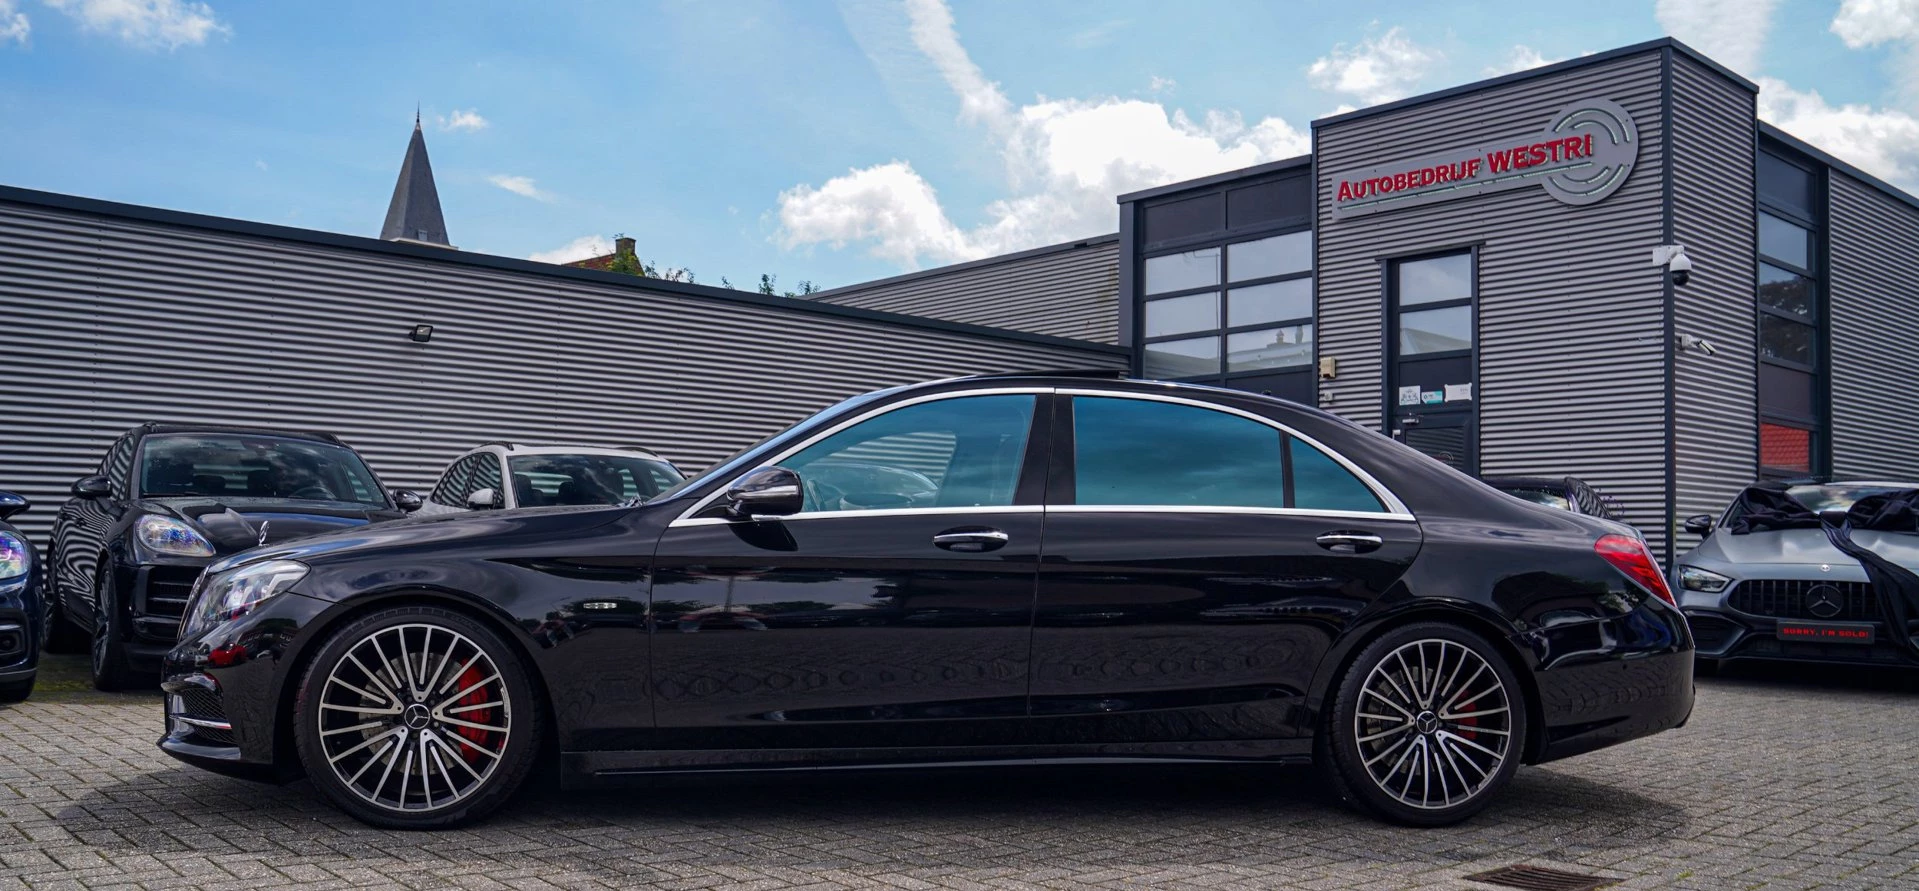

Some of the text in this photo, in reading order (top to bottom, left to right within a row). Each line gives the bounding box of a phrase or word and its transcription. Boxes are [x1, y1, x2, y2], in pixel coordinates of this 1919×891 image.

[1487, 134, 1592, 173] WESTRI
[1783, 628, 1818, 636] SORRY,
[1838, 630, 1869, 638] SOLD!
